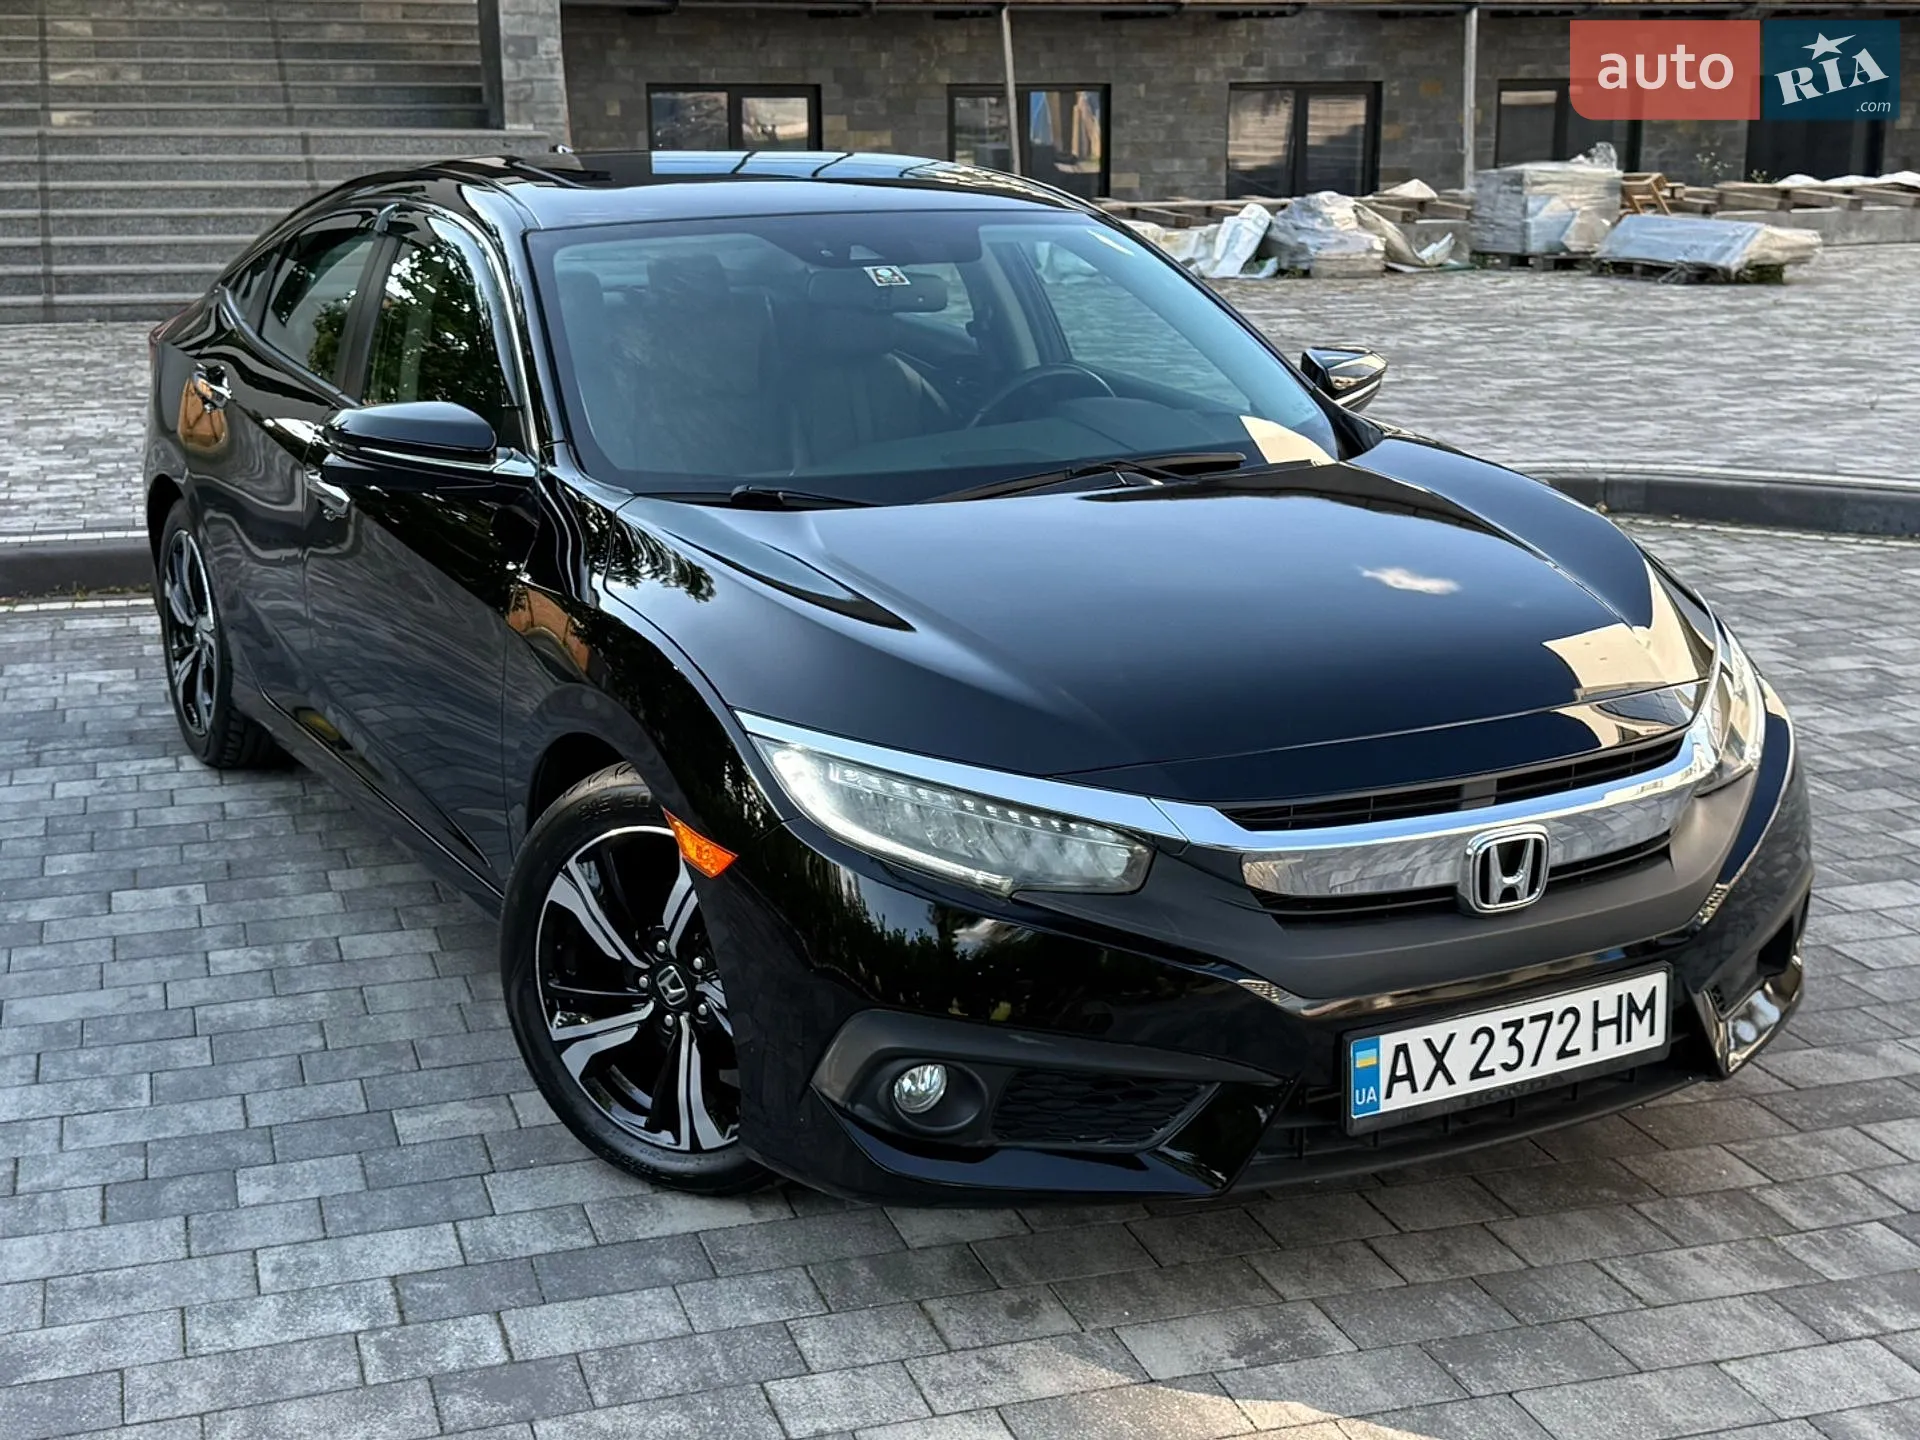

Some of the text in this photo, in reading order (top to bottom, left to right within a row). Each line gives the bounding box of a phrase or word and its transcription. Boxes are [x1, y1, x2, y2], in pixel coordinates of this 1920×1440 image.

[1385, 986, 1657, 1099] AX 2372 HM
[1355, 1086, 1377, 1105] UA
